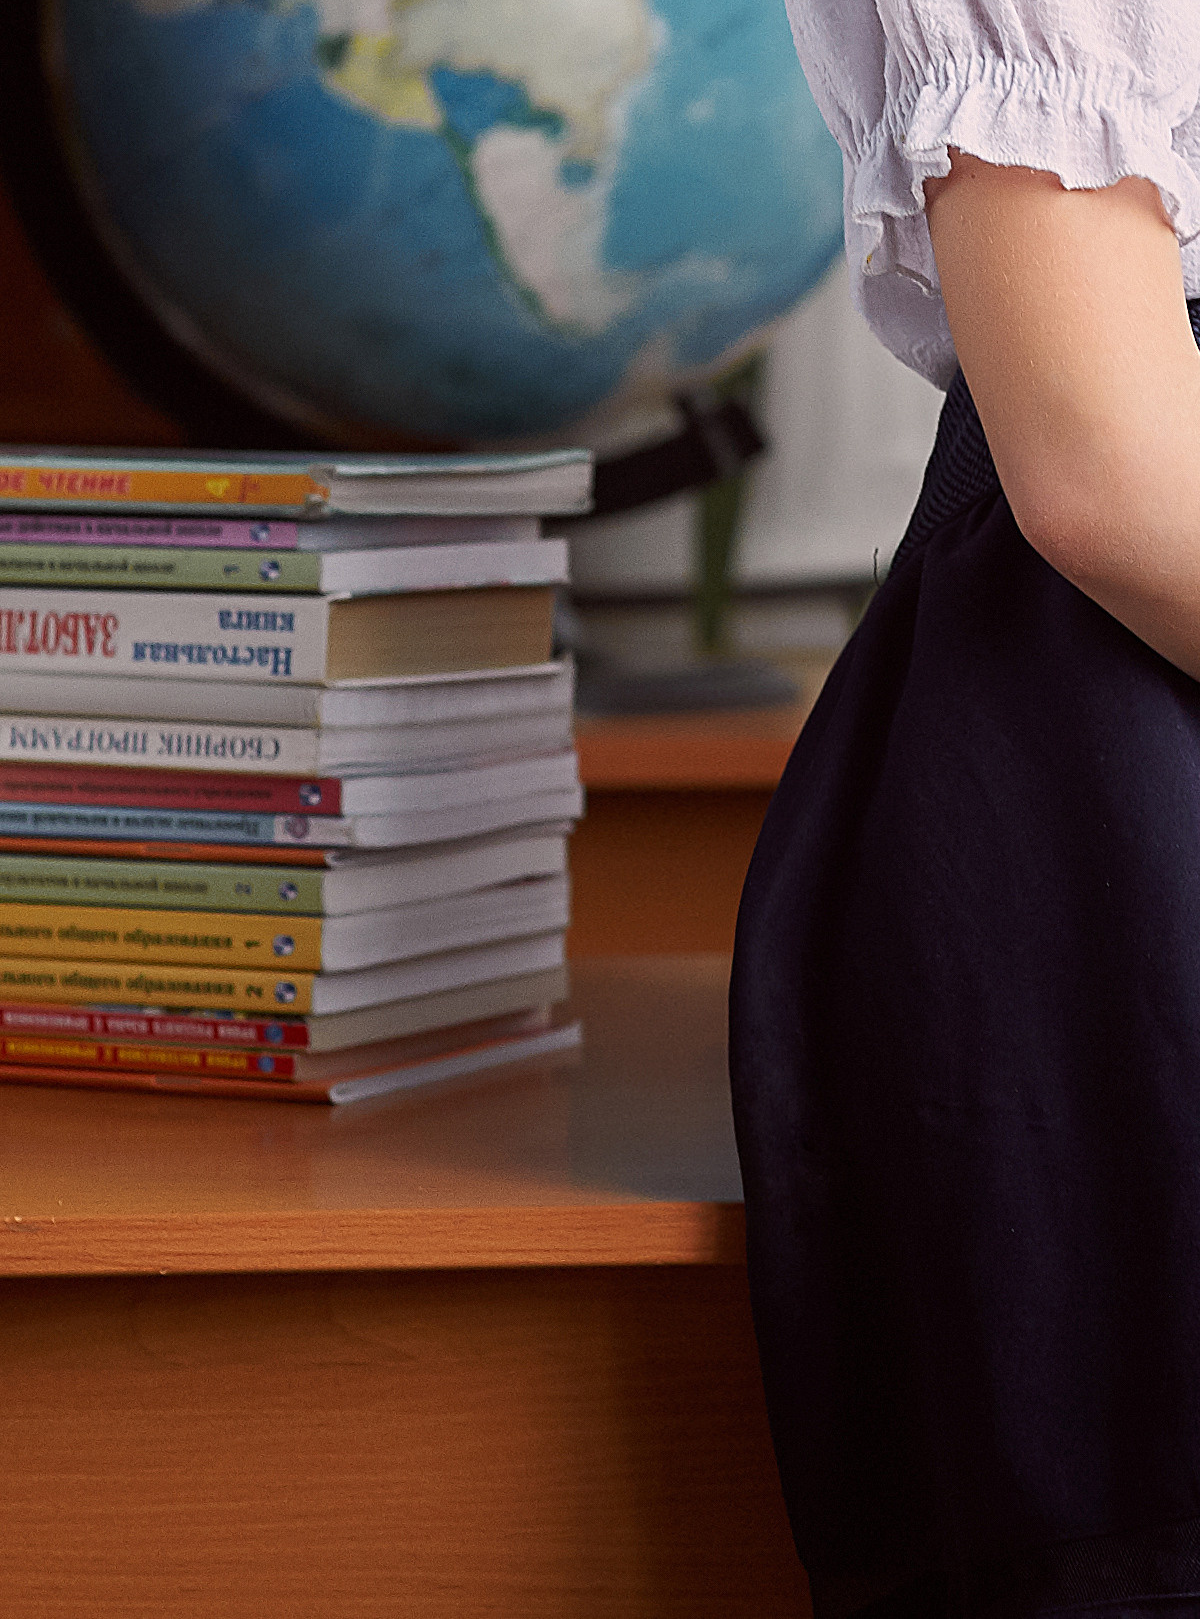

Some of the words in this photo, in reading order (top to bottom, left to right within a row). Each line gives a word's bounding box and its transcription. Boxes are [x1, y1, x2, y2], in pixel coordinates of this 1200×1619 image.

[39, 472, 132, 495] ЧТЕНИЕ
[219, 609, 295, 632] книга
[131, 641, 293, 676] Настольная
[9, 726, 149, 756] ПРОГРАММ
[158, 733, 281, 762] СБОРНИК
[57, 924, 119, 943] общего
[123, 928, 234, 950] образования
[60, 970, 122, 990] общего
[126, 973, 236, 997] образования
